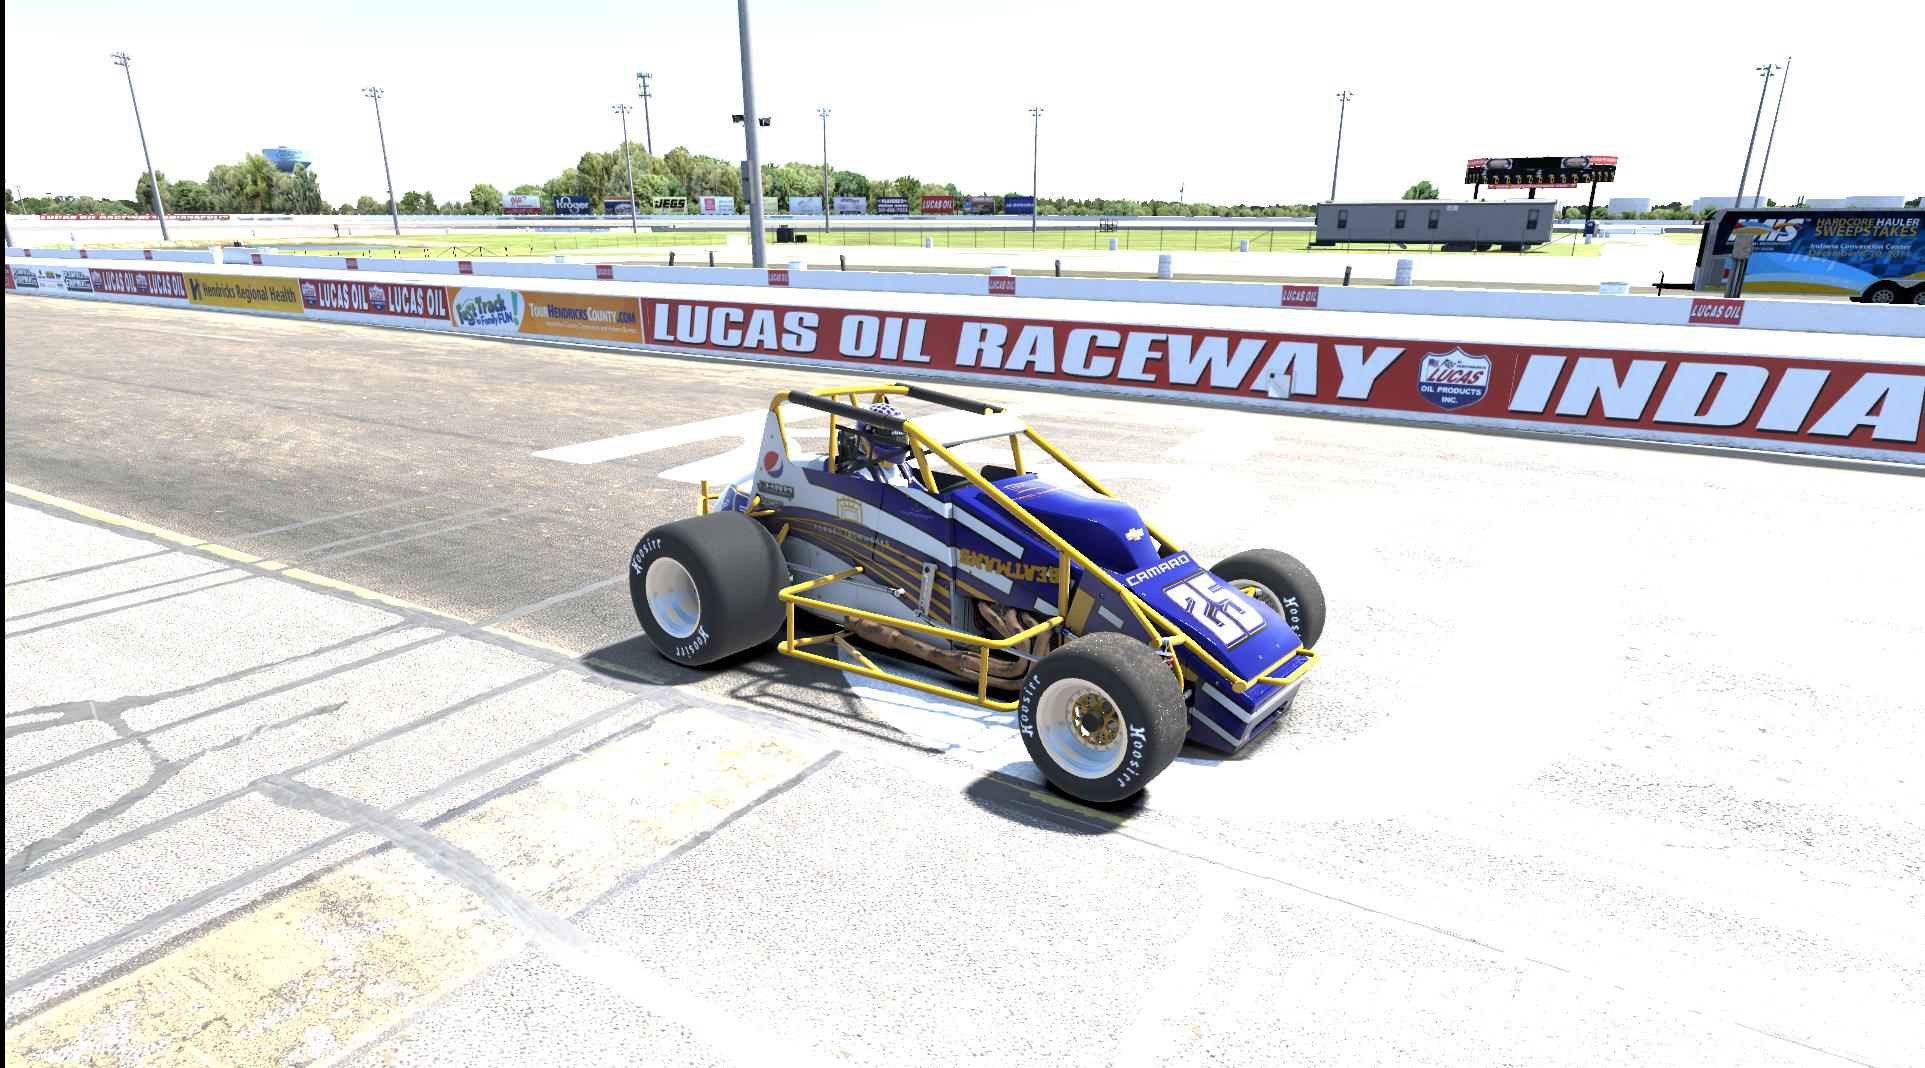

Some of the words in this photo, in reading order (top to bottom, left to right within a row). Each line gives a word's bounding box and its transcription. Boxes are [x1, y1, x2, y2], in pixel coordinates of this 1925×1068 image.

[556, 197, 589, 214] Kroger
[654, 199, 685, 208] JEGS
[923, 200, 943, 209] LUCAS
[943, 200, 953, 209] OIL
[1817, 218, 1874, 227] HARDCORE
[1876, 218, 1920, 227] HAULER
[1814, 226, 1918, 237] SWEEPSTAKES
[1840, 243, 1884, 251] Convention
[1885, 243, 1913, 251] Center
[102, 271, 125, 292] LUCAS
[124, 272, 138, 292] OIL
[148, 273, 172, 296] LUCAS
[171, 275, 185, 297] OIL
[202, 282, 235, 298] Hendricks
[236, 284, 268, 304] Regional
[269, 286, 297, 303] Health
[318, 282, 350, 310] LUCAS
[351, 284, 369, 310] OIL
[387, 286, 424, 315] LUCAS
[426, 288, 446, 316] OIL
[1283, 290, 1305, 302] LUCAS
[1306, 291, 1317, 302] OIL
[456, 303, 477, 326] Fast
[475, 294, 506, 315] Track
[1691, 305, 1724, 318] LUCAS
[1724, 305, 1741, 319] OIL
[654, 303, 820, 353] LUCAS
[839, 314, 931, 364] OIL
[955, 321, 1406, 401] RACEWAY
[1426, 368, 1484, 384] LUCAS
[1421, 385, 1434, 393] OIL
[1437, 386, 1482, 396] PRODUCTS
[1509, 354, 1925, 443] INDIA
[1441, 396, 1458, 404] INC.
[1126, 554, 1190, 587] CAMARO
[1162, 569, 1268, 651] 25
